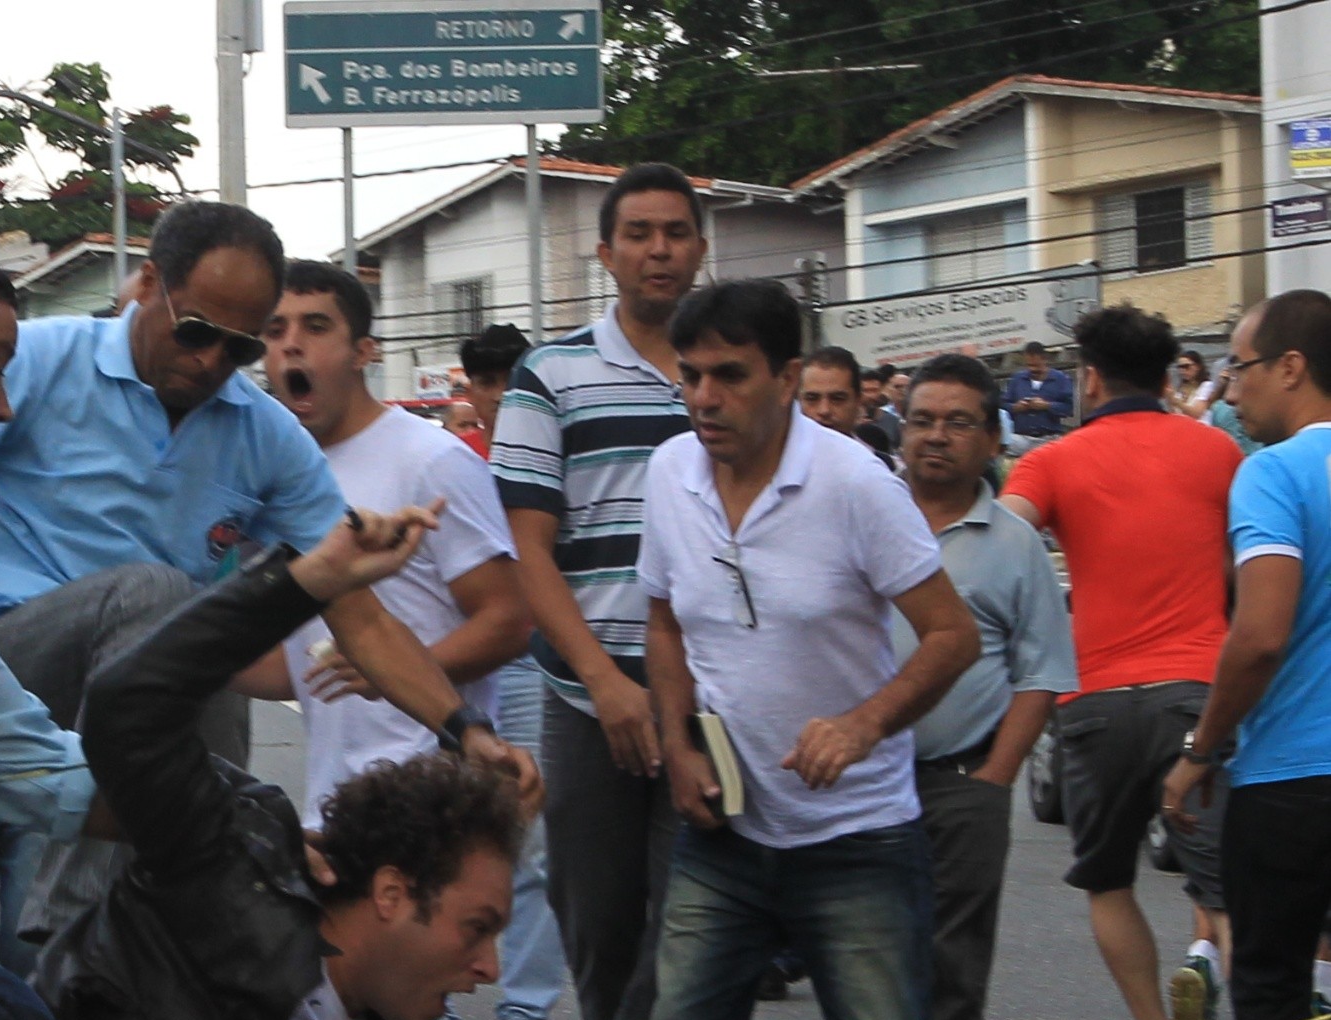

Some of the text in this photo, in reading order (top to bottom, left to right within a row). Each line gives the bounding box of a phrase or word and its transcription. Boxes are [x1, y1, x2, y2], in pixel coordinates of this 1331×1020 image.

[435, 19, 535, 40] RETORNO
[342, 57, 579, 82] Pça. dos Bombeiros
[343, 83, 522, 107] B. Ferrazópolis
[872, 301, 947, 325] Serviços
[949, 287, 1029, 315] Especiais
